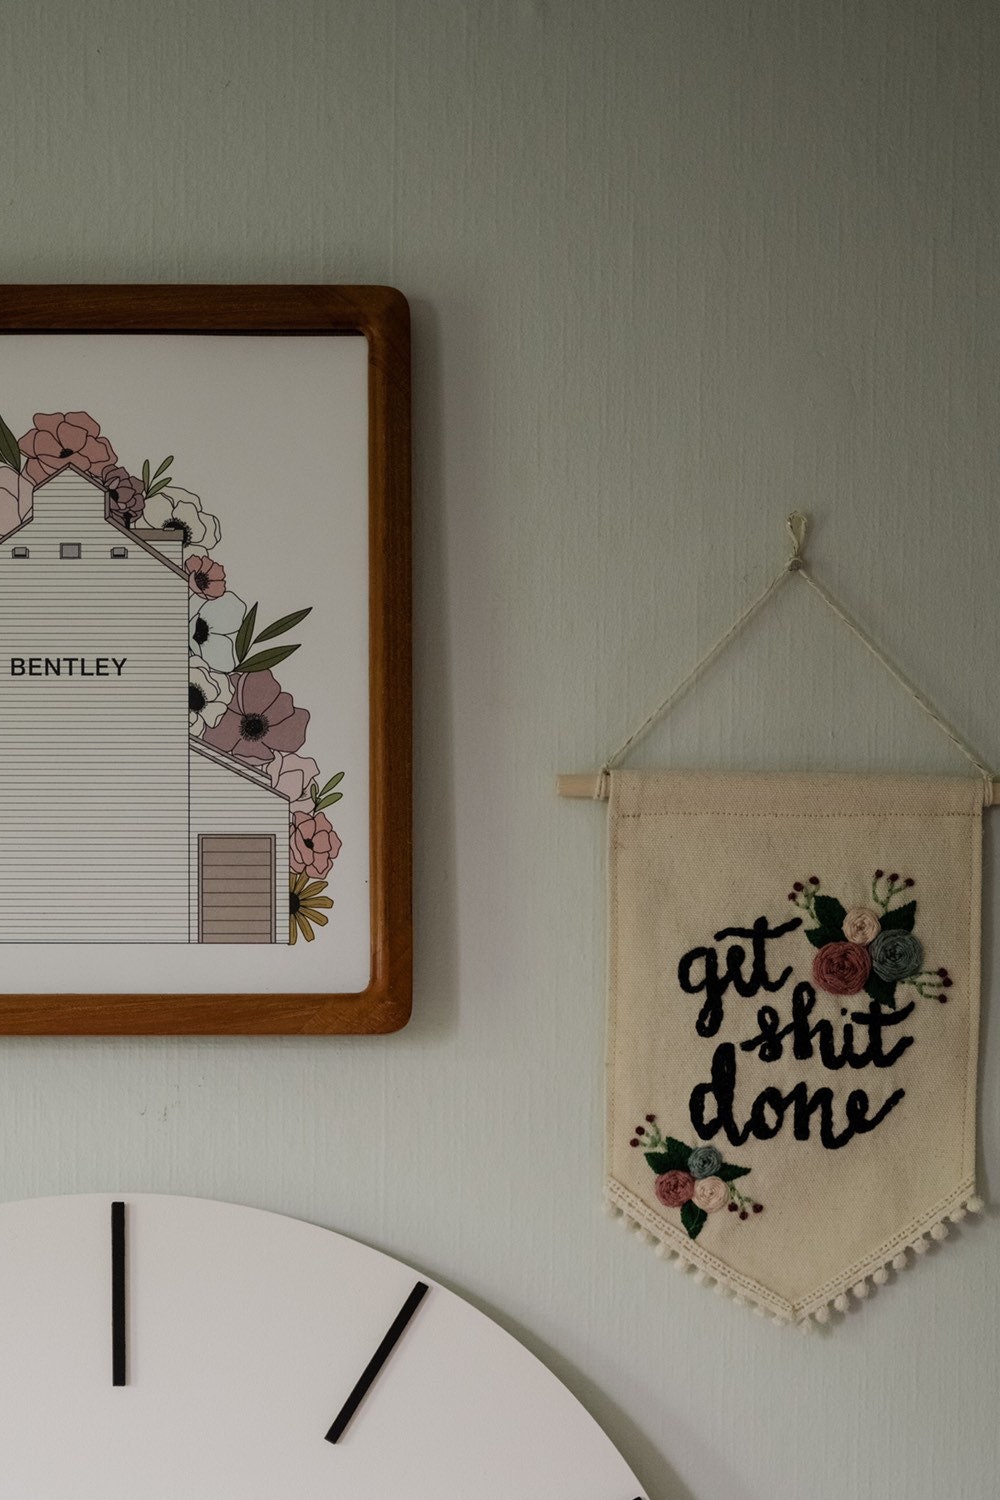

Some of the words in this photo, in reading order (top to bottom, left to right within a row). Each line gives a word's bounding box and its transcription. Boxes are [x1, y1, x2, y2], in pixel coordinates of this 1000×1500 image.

[10, 658, 128, 676] BENTLEY
[677, 915, 803, 1038] get
[740, 981, 915, 1070] shit
[688, 1042, 906, 1150] done
